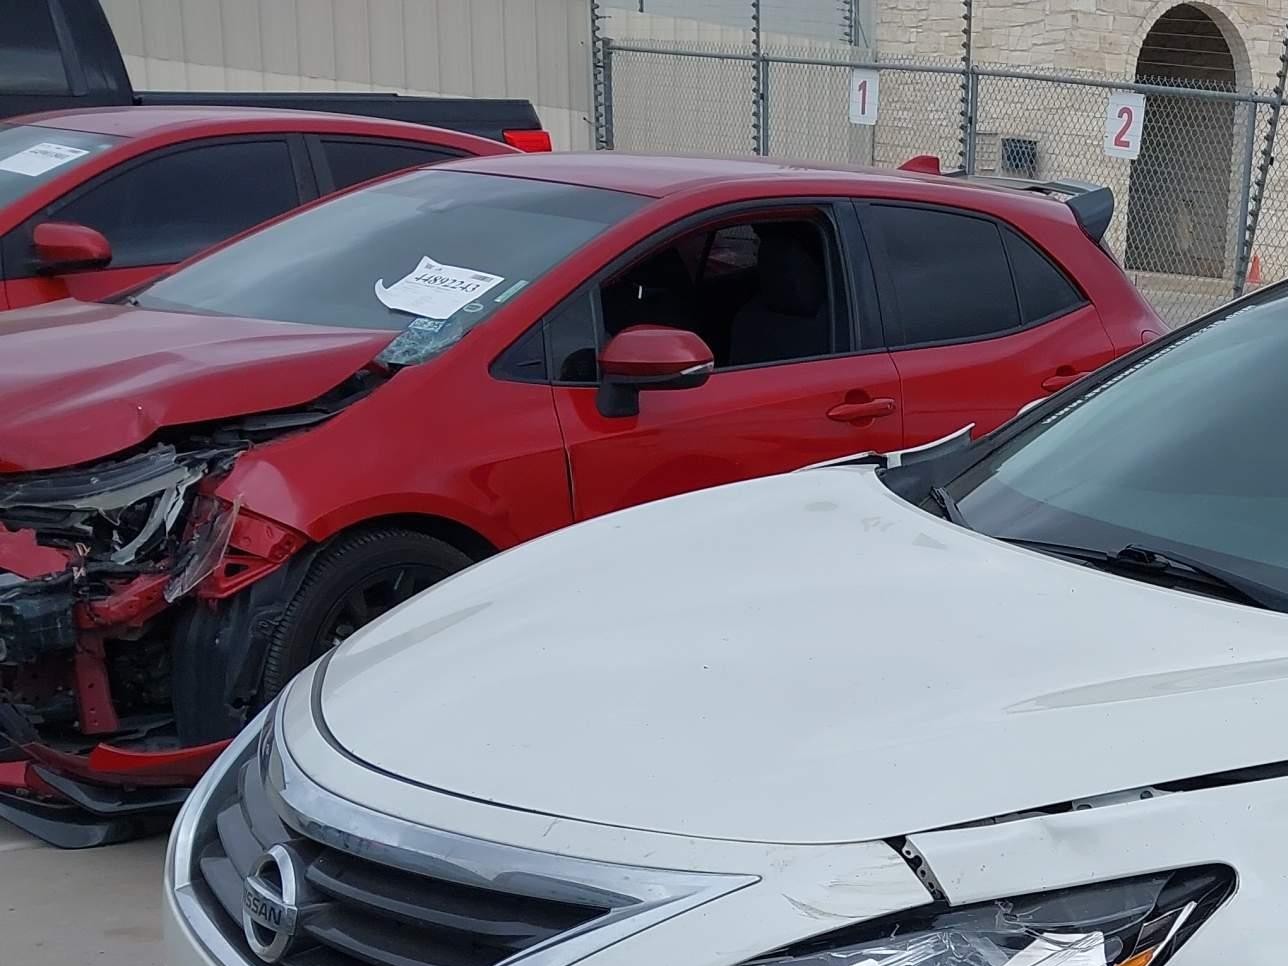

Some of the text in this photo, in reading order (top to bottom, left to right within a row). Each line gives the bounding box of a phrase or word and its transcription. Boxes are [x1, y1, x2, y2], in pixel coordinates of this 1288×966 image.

[857, 80, 867, 115] 1
[1114, 106, 1133, 148] 2
[414, 273, 481, 293] 44892243
[243, 889, 283, 925] SSAN
